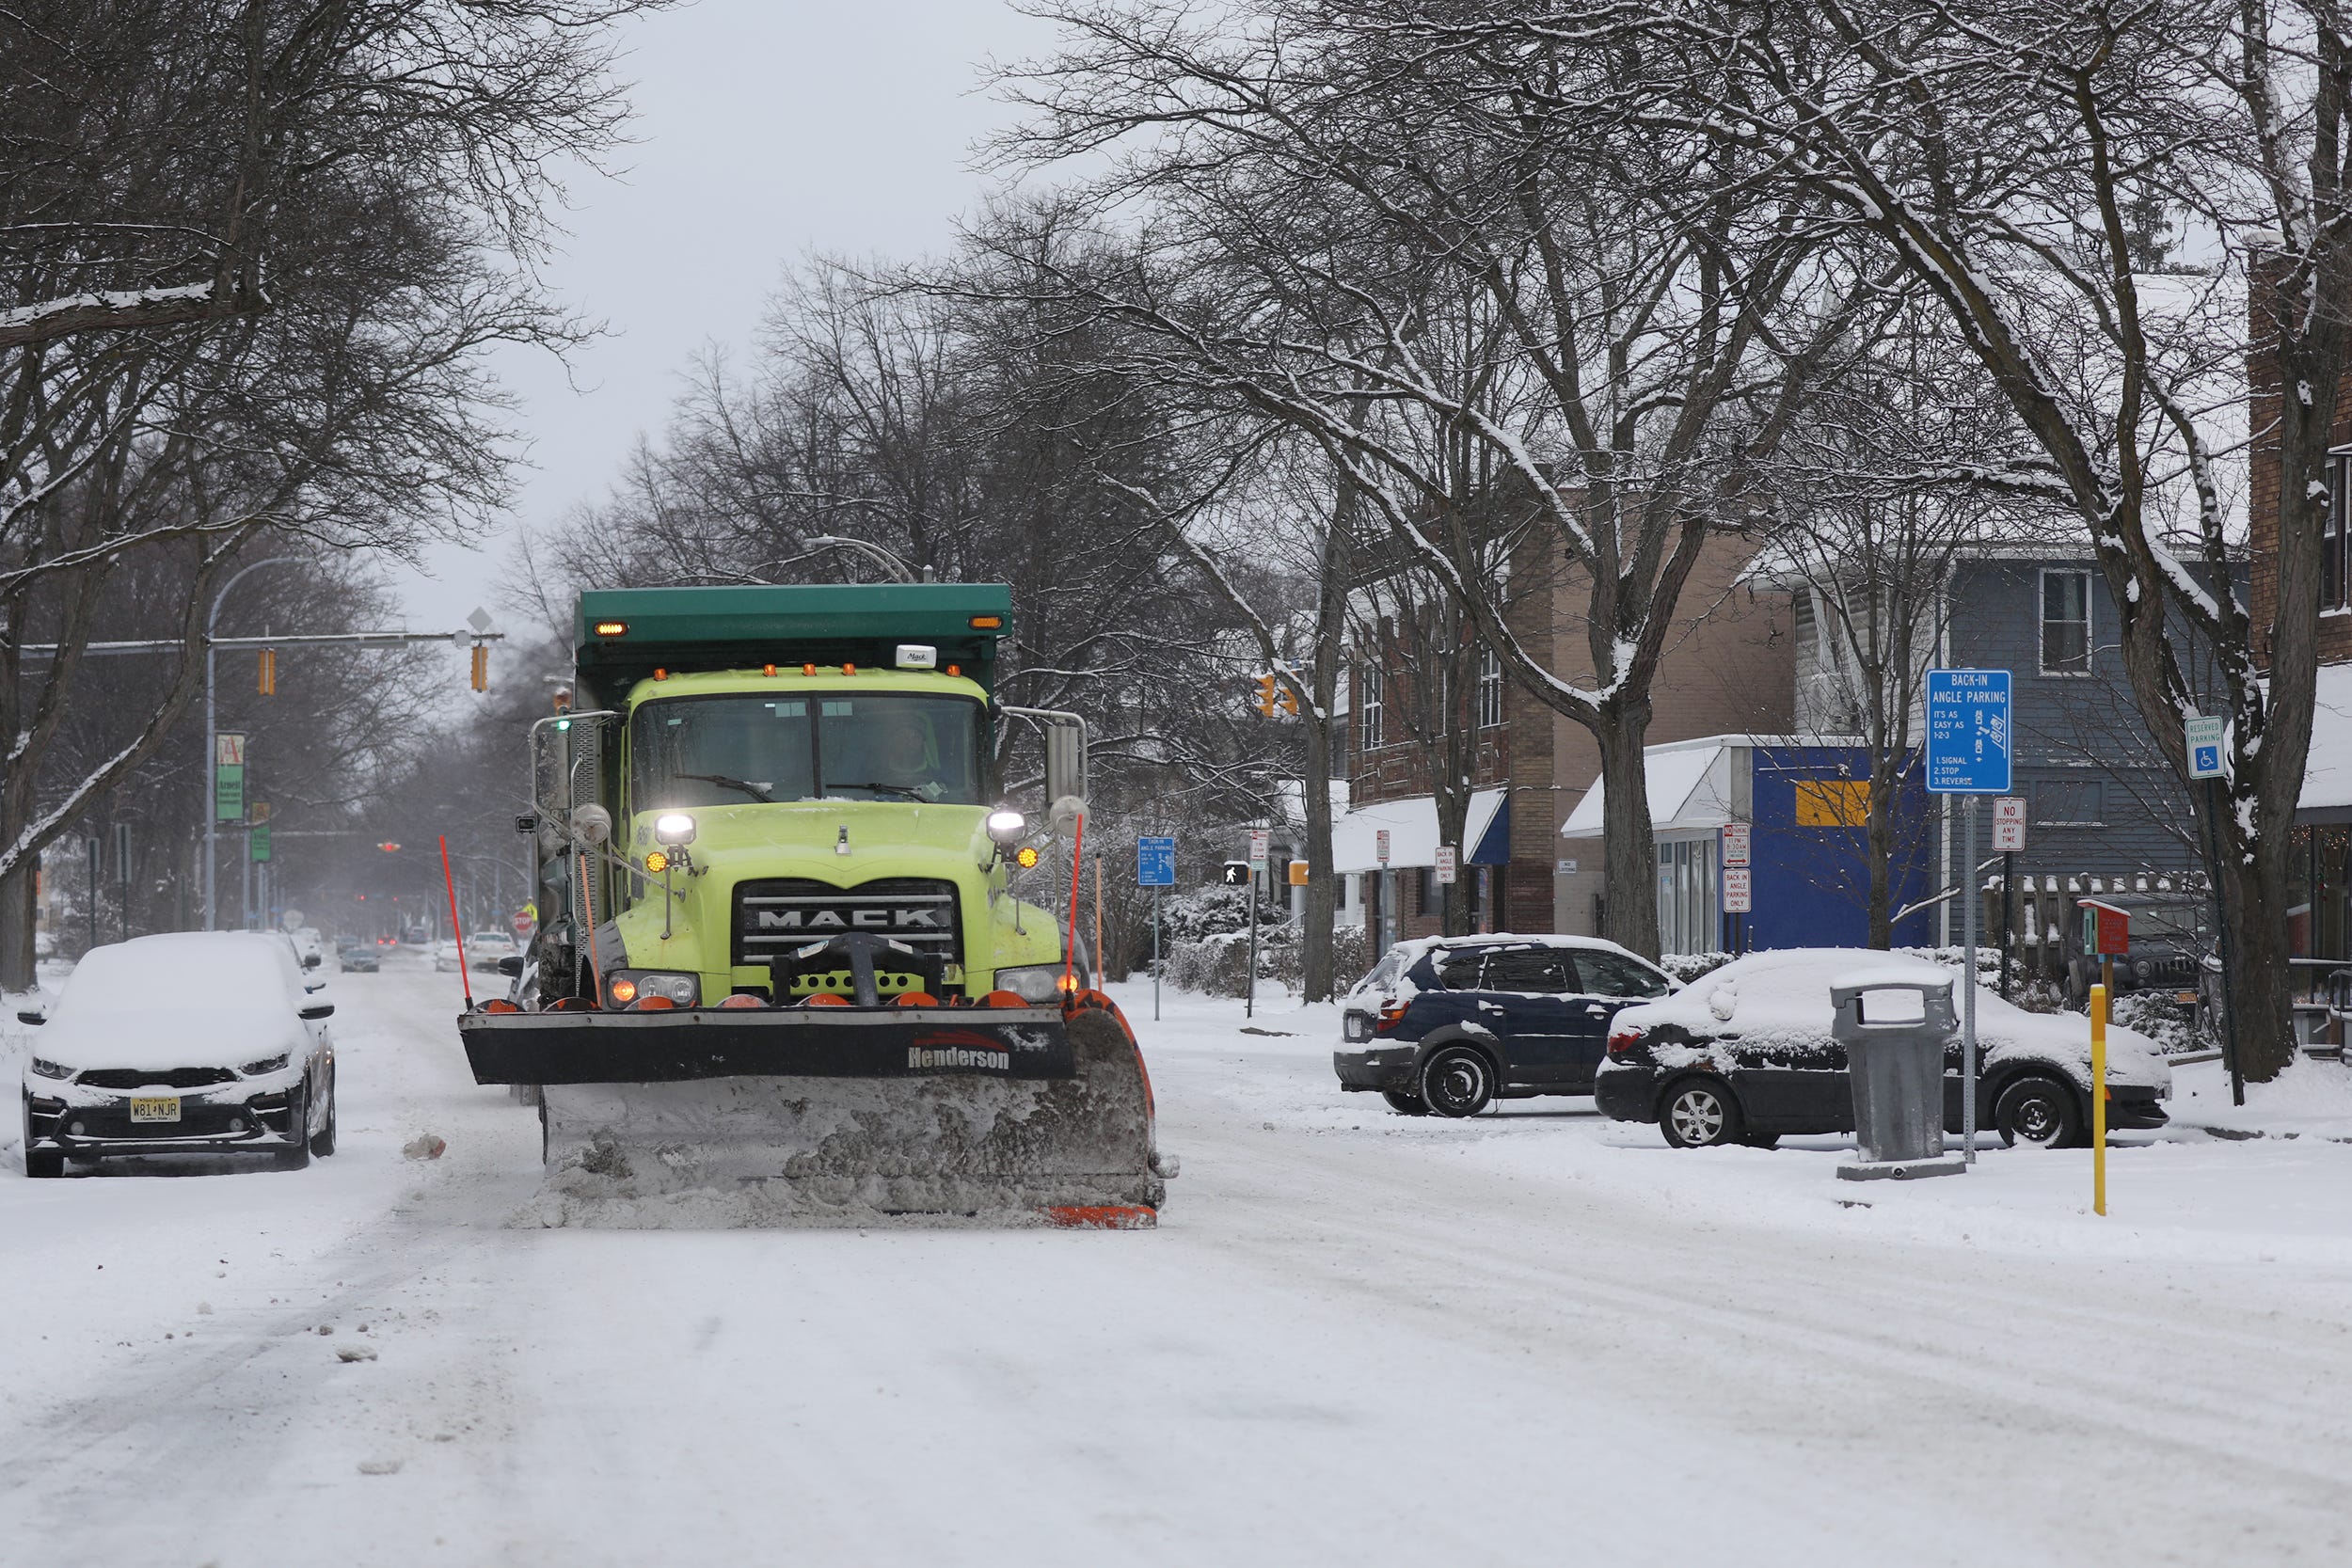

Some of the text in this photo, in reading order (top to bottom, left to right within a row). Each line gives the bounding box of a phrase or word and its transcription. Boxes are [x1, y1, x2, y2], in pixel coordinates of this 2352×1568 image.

[1951, 673, 1988, 687] BACK-IN
[1932, 691, 2006, 704] ANGLE PARKING
[1948, 710, 1958, 719] AS
[1933, 721, 1964, 729] EASY AS
[2189, 722, 2219, 733] RESERVED
[1933, 731, 1950, 739] 1-2-3
[2190, 734, 2220, 743] PARKING
[219, 736, 242, 763] A
[2004, 806, 2016, 816] NO
[2002, 835, 2015, 844] TIME
[758, 909, 938, 927] MACK
[908, 1046, 1009, 1070] Henderson
